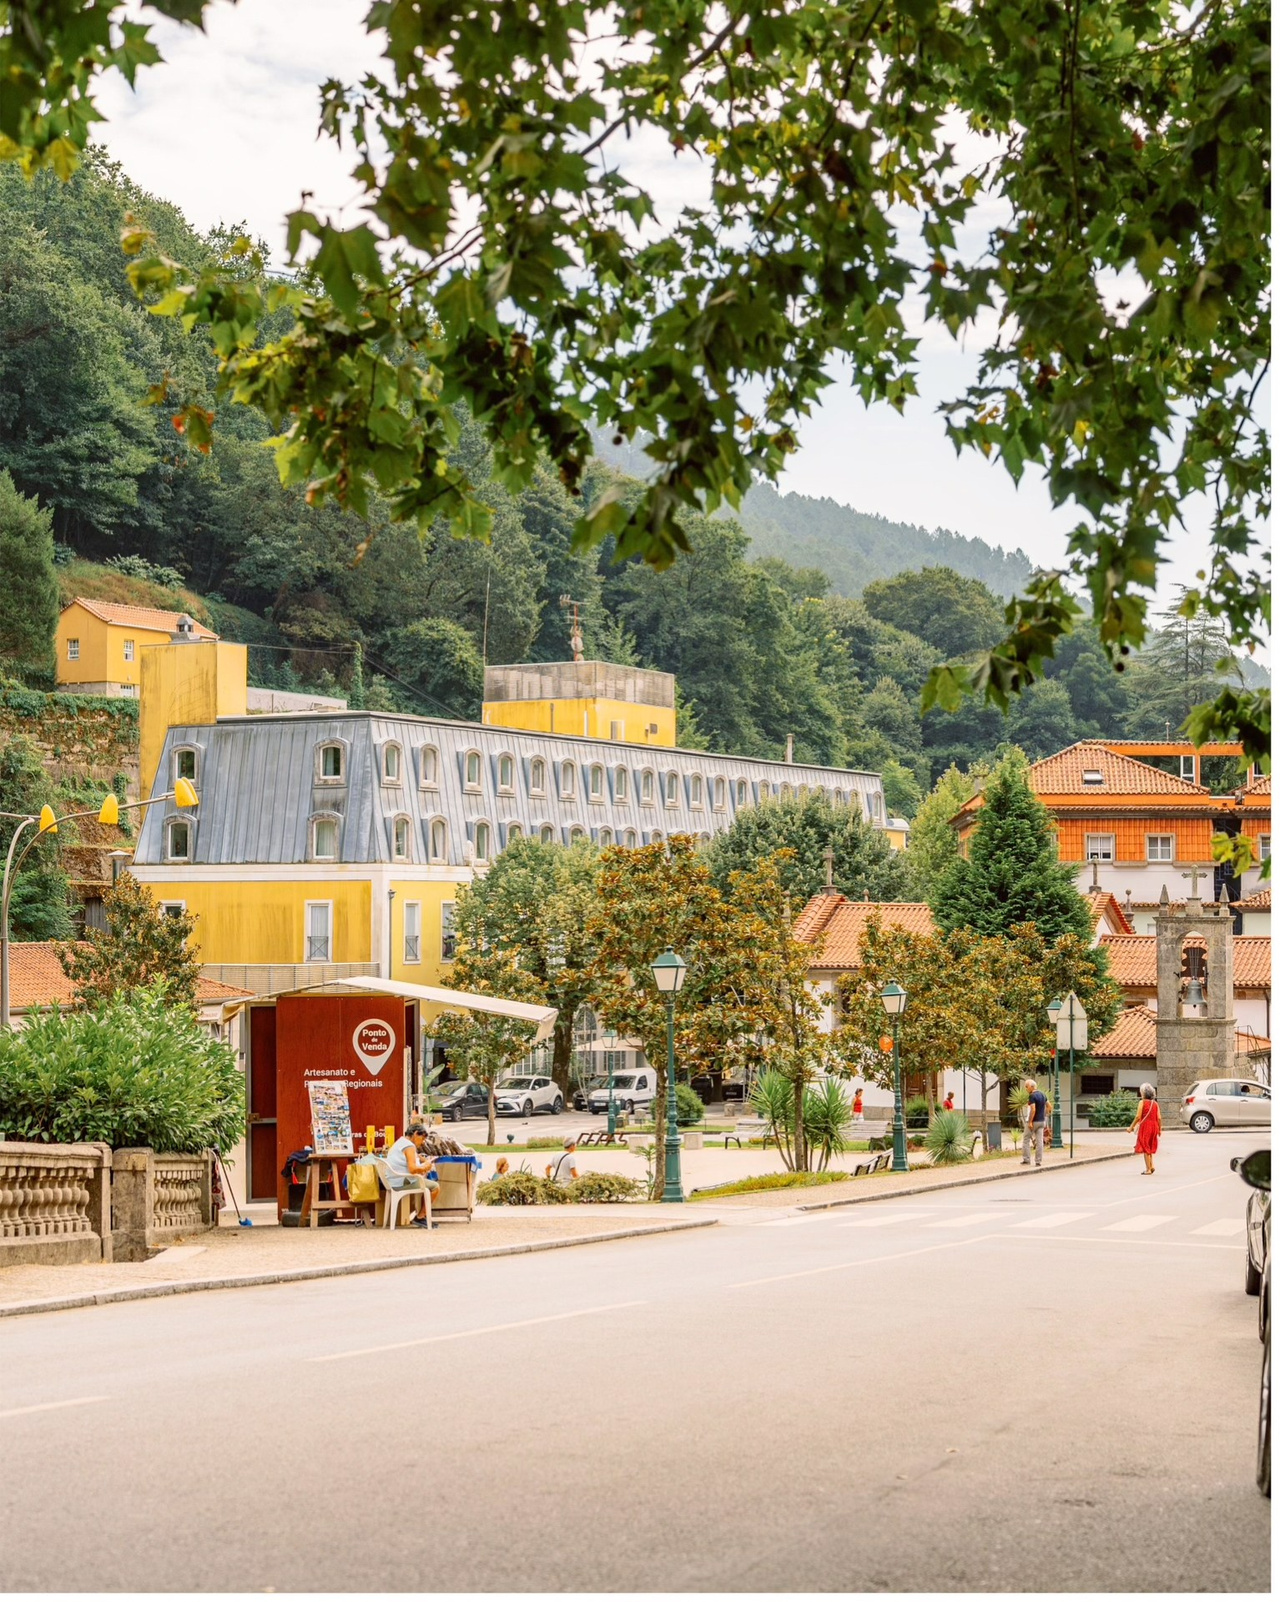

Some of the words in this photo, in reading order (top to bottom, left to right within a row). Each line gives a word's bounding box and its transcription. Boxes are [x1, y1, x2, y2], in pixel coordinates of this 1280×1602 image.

[362, 1029, 387, 1037] Ponto
[362, 1042, 387, 1050] Venda
[304, 1068, 348, 1076] Artesanato
